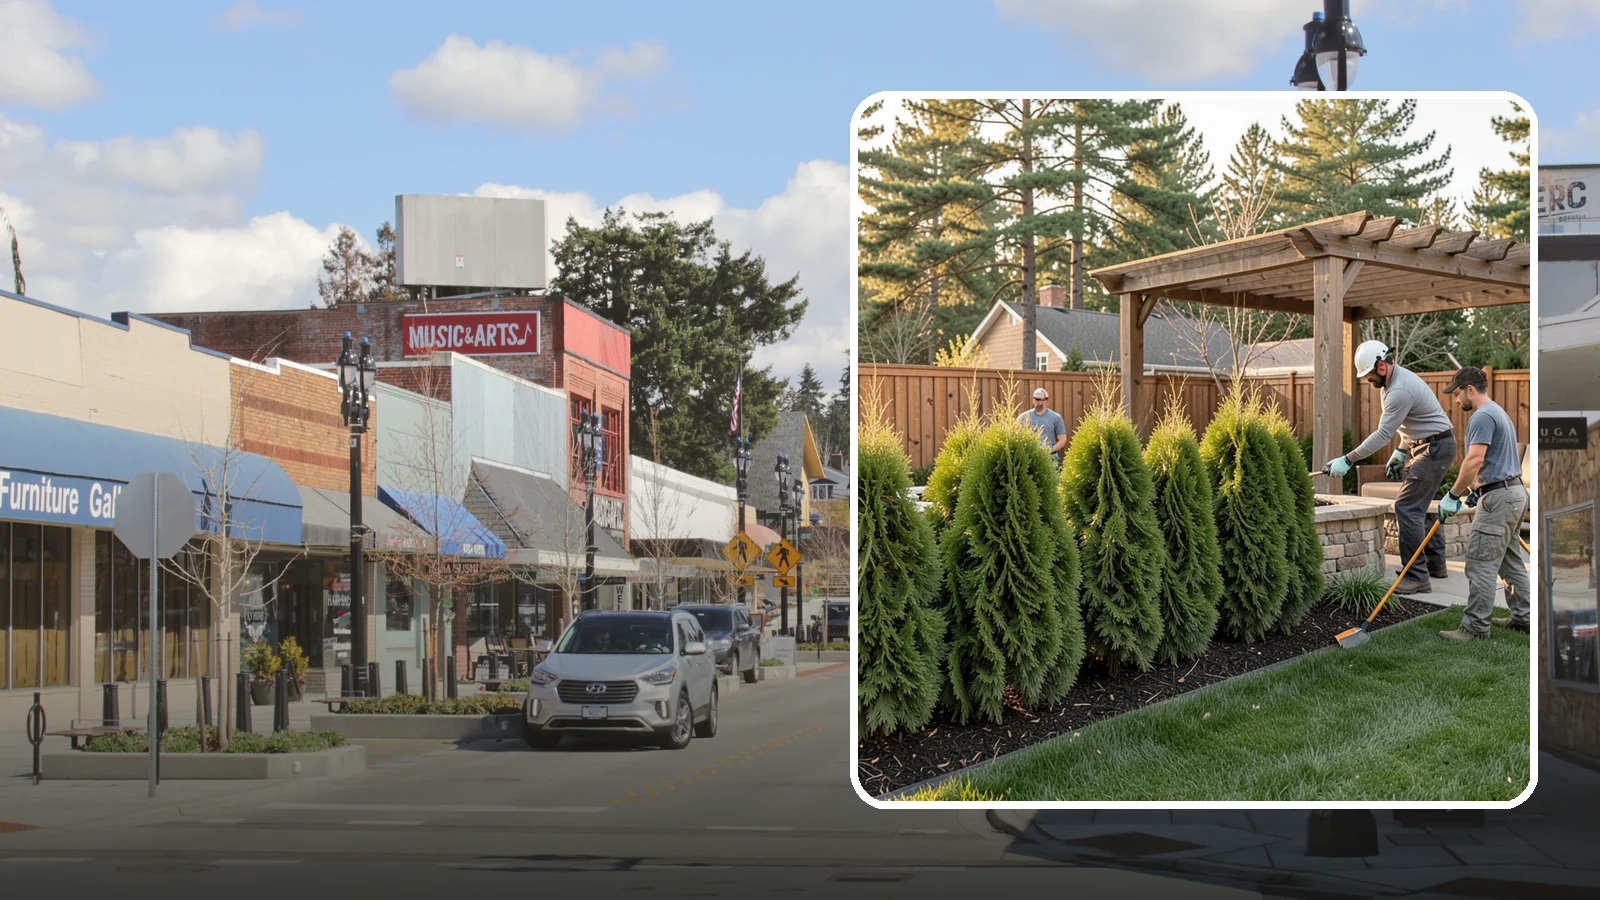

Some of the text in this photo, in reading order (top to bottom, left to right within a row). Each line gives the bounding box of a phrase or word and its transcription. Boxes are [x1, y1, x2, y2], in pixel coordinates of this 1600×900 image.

[1540, 427, 1577, 436] UGA
[1551, 436, 1579, 445] Framing
[0, 471, 79, 515] Furniture
[453, 562, 480, 574] SUSHI
